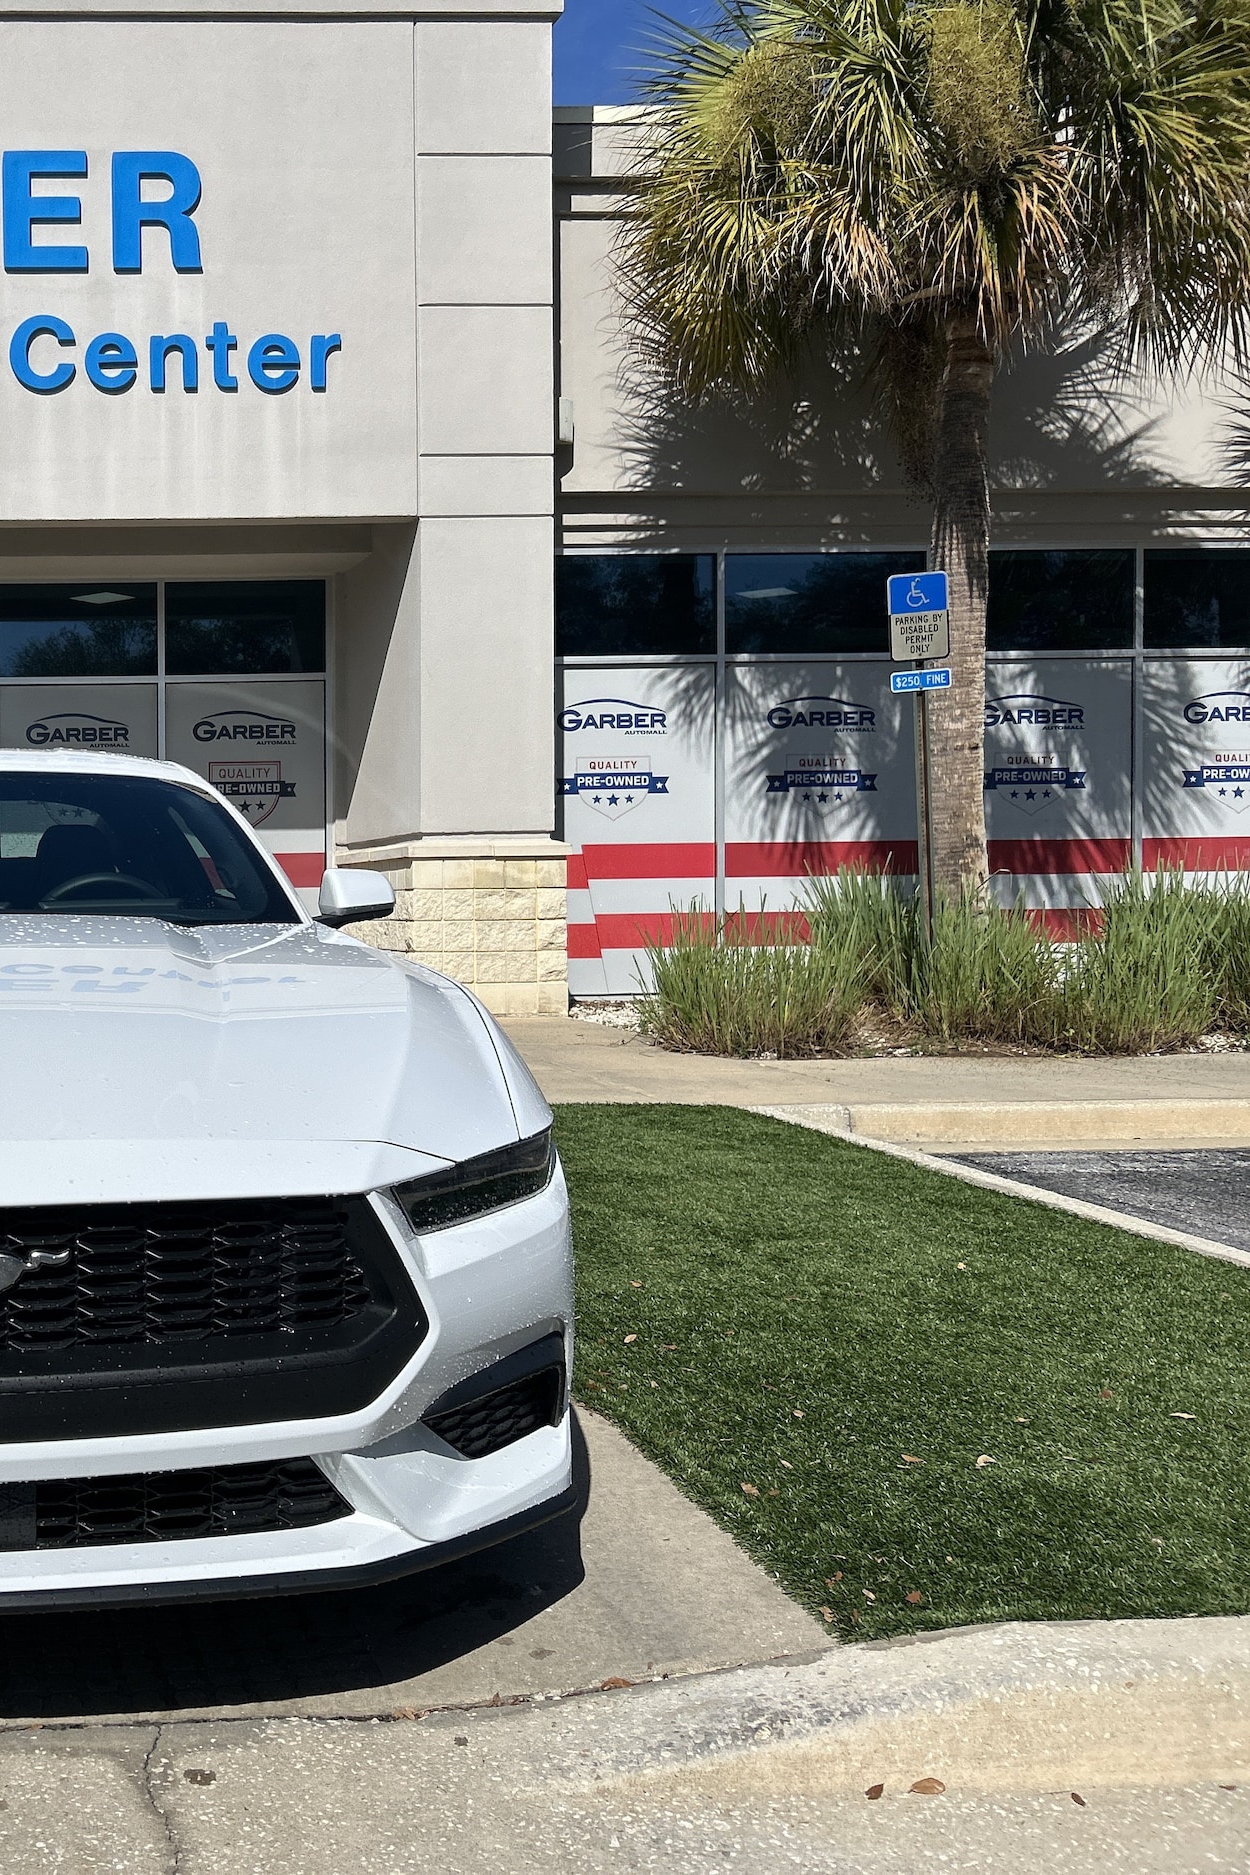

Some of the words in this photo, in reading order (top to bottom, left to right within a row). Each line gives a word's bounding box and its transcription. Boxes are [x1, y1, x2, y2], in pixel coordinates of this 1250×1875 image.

[8, 315, 342, 394] Center
[895, 615, 929, 626] PARKING
[933, 613, 943, 622] BY
[900, 623, 939, 635] DISABLED
[905, 633, 934, 644] PERMIT
[910, 644, 930, 654] ONLY
[896, 676, 920, 688] $250
[926, 673, 947, 685] FINE
[767, 707, 876, 729] GARBER
[984, 704, 1085, 727] GARBER
[1184, 702, 1250, 724] GARB
[557, 709, 667, 732] GARBER
[26, 723, 130, 745] GARBER
[192, 720, 297, 742] GARBER
[799, 758, 846, 767] QUALITY
[1007, 756, 1055, 765] QUALITY
[1215, 753, 1249, 763] QUALI
[589, 760, 637, 770] QUALITY
[219, 768, 270, 779] QUALITY
[787, 773, 858, 784] PRE-OWNED
[995, 771, 1066, 782] PRE-OWNED
[1203, 768, 1250, 779] PRE-OW
[577, 776, 649, 787] PRE-OWNED
